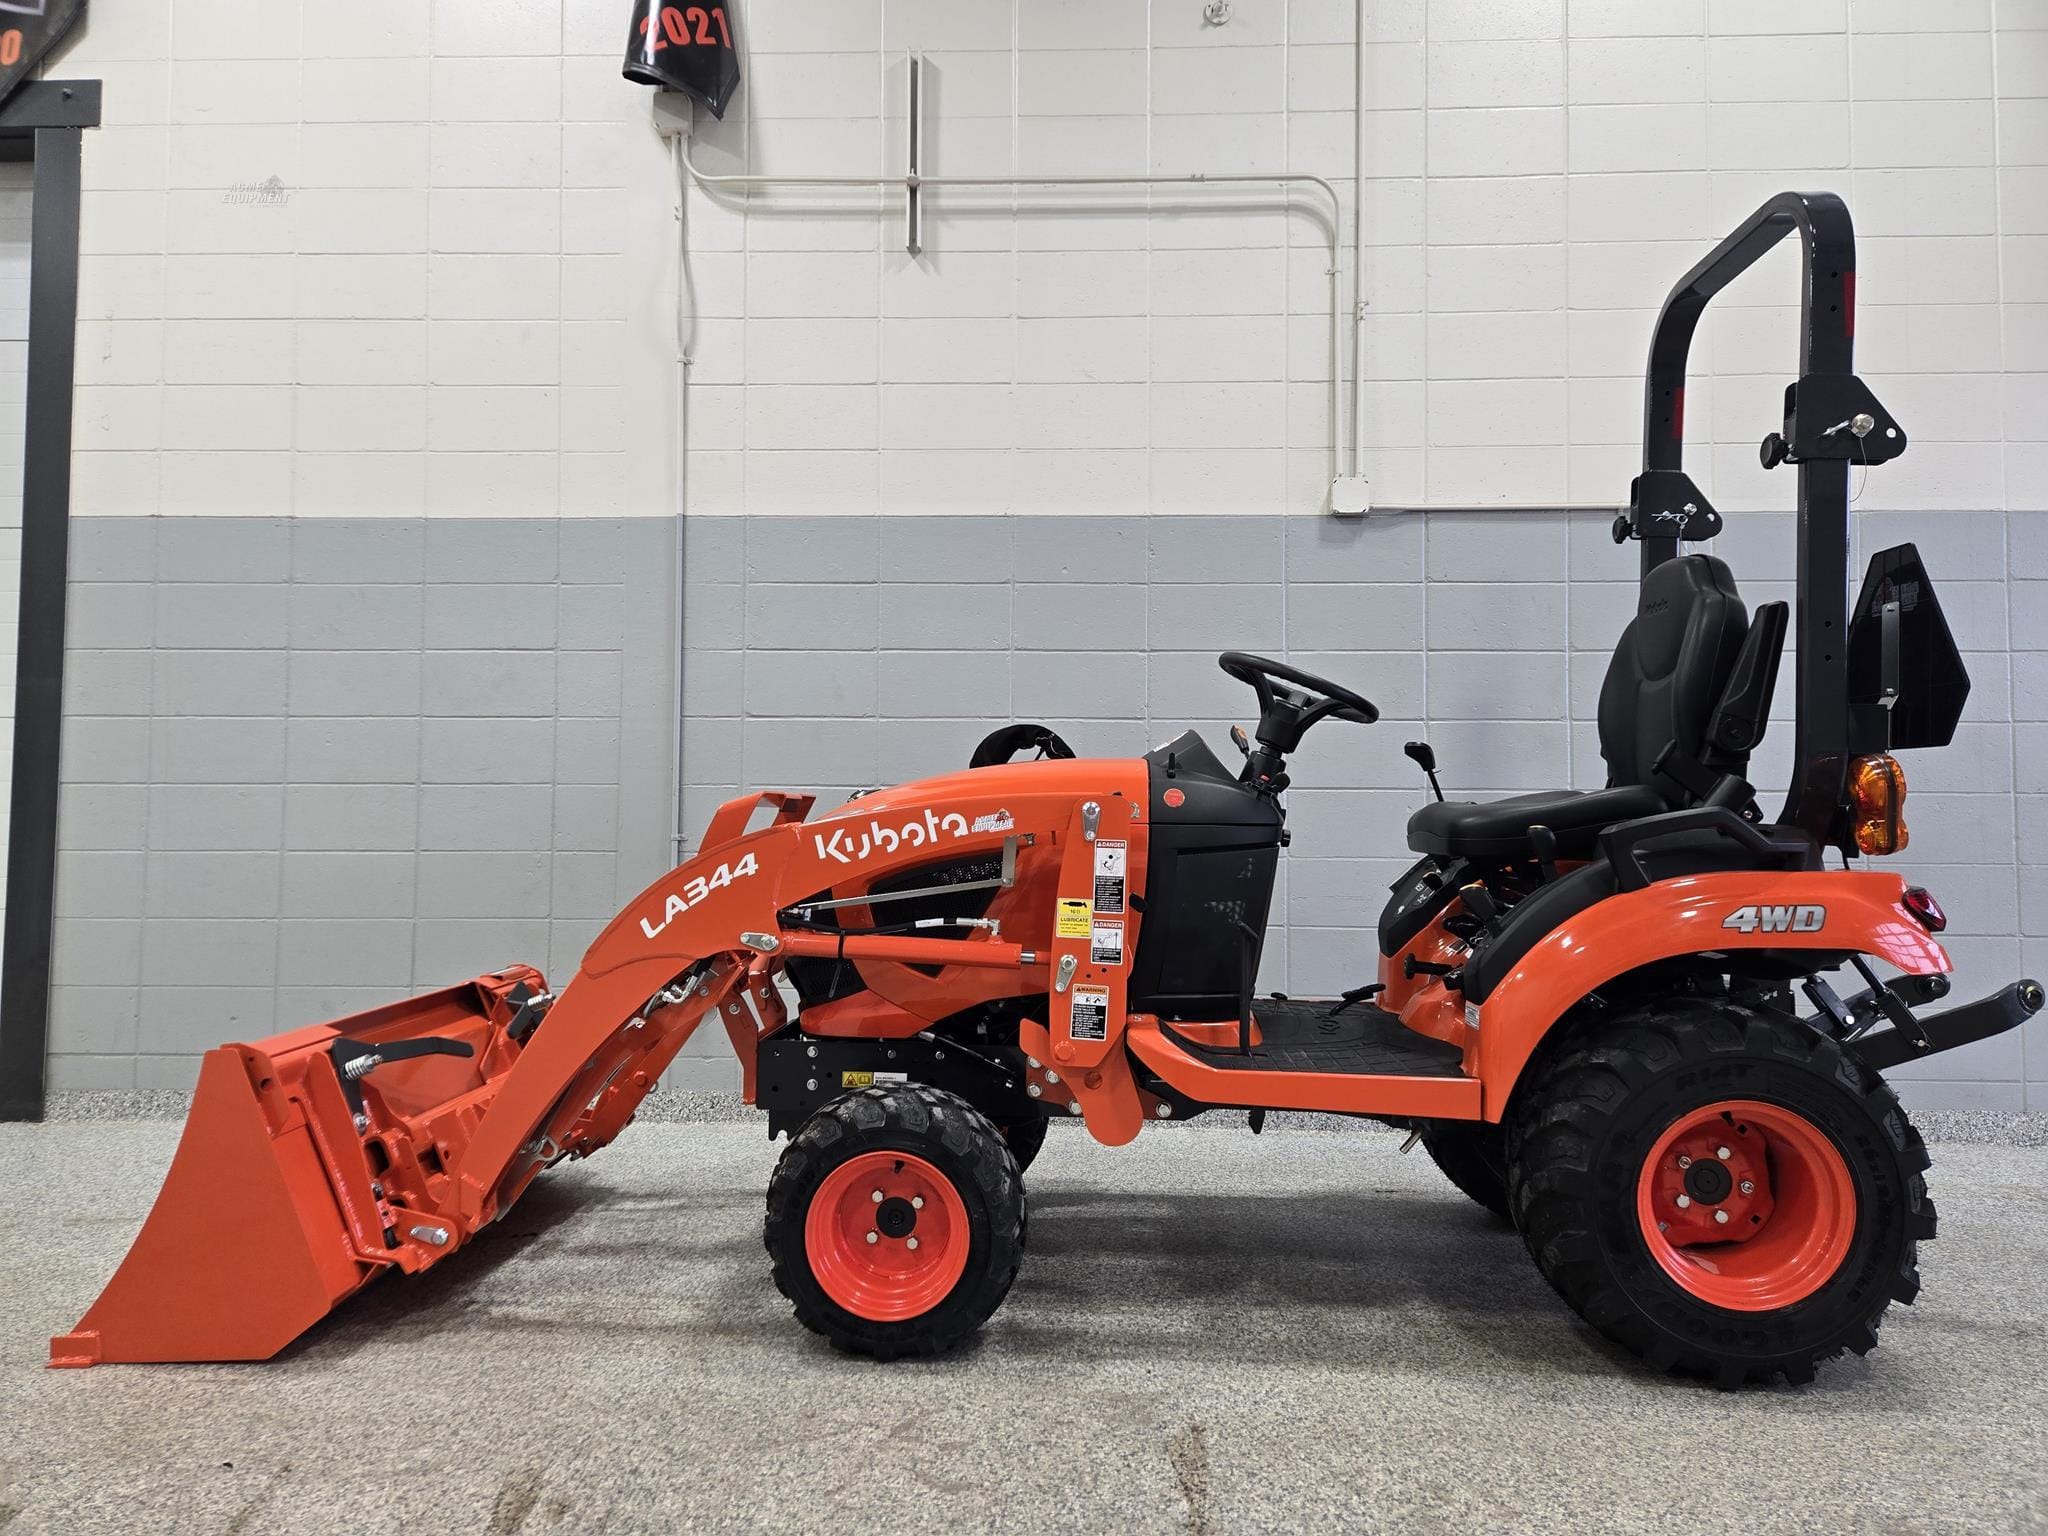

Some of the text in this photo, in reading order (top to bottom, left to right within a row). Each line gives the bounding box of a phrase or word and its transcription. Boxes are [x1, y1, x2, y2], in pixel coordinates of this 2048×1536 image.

[639, 6, 732, 52] 2021
[814, 808, 969, 864] Kubota
[639, 851, 759, 939] LA344
[1721, 904, 1826, 933] 4WD
[1080, 987, 1106, 995] WARNING
